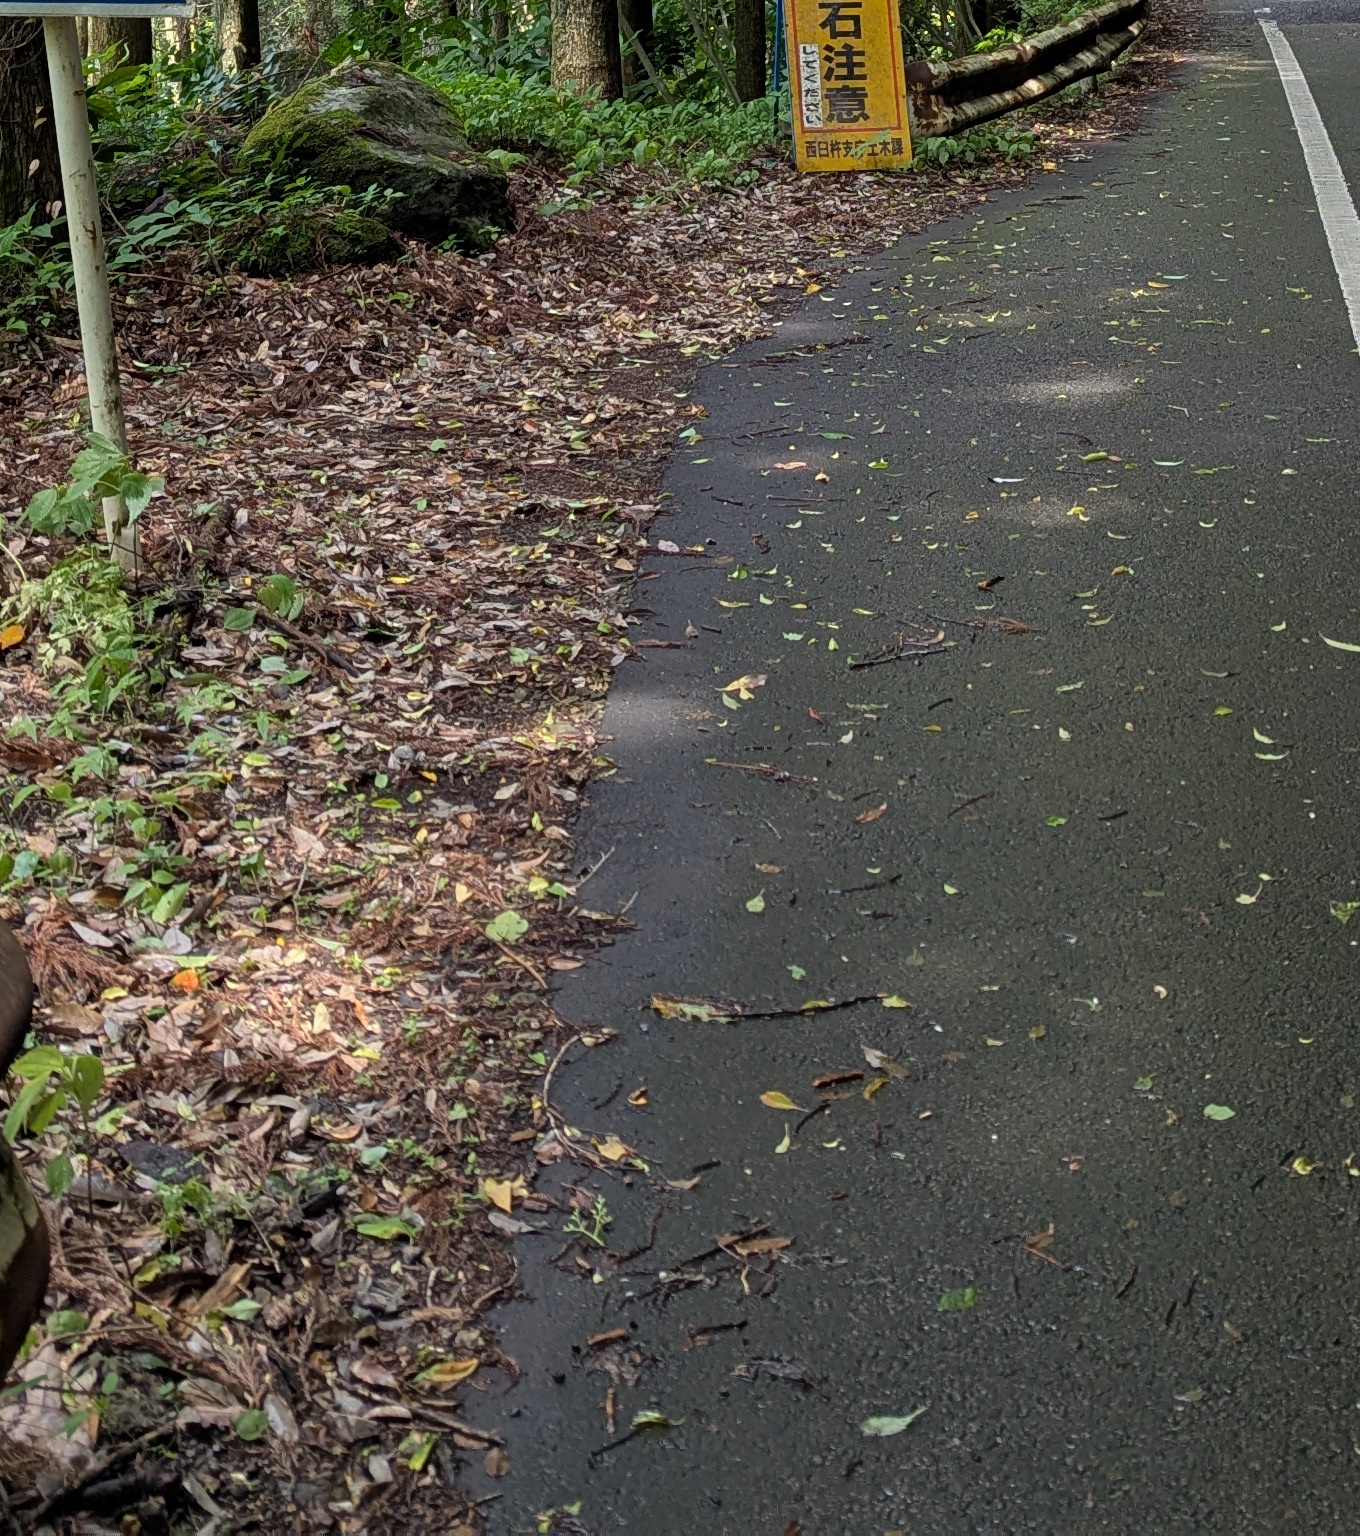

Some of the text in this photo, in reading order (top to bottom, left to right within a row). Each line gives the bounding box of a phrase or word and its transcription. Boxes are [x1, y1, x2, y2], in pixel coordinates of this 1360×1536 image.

[802, 45, 822, 124] してください
